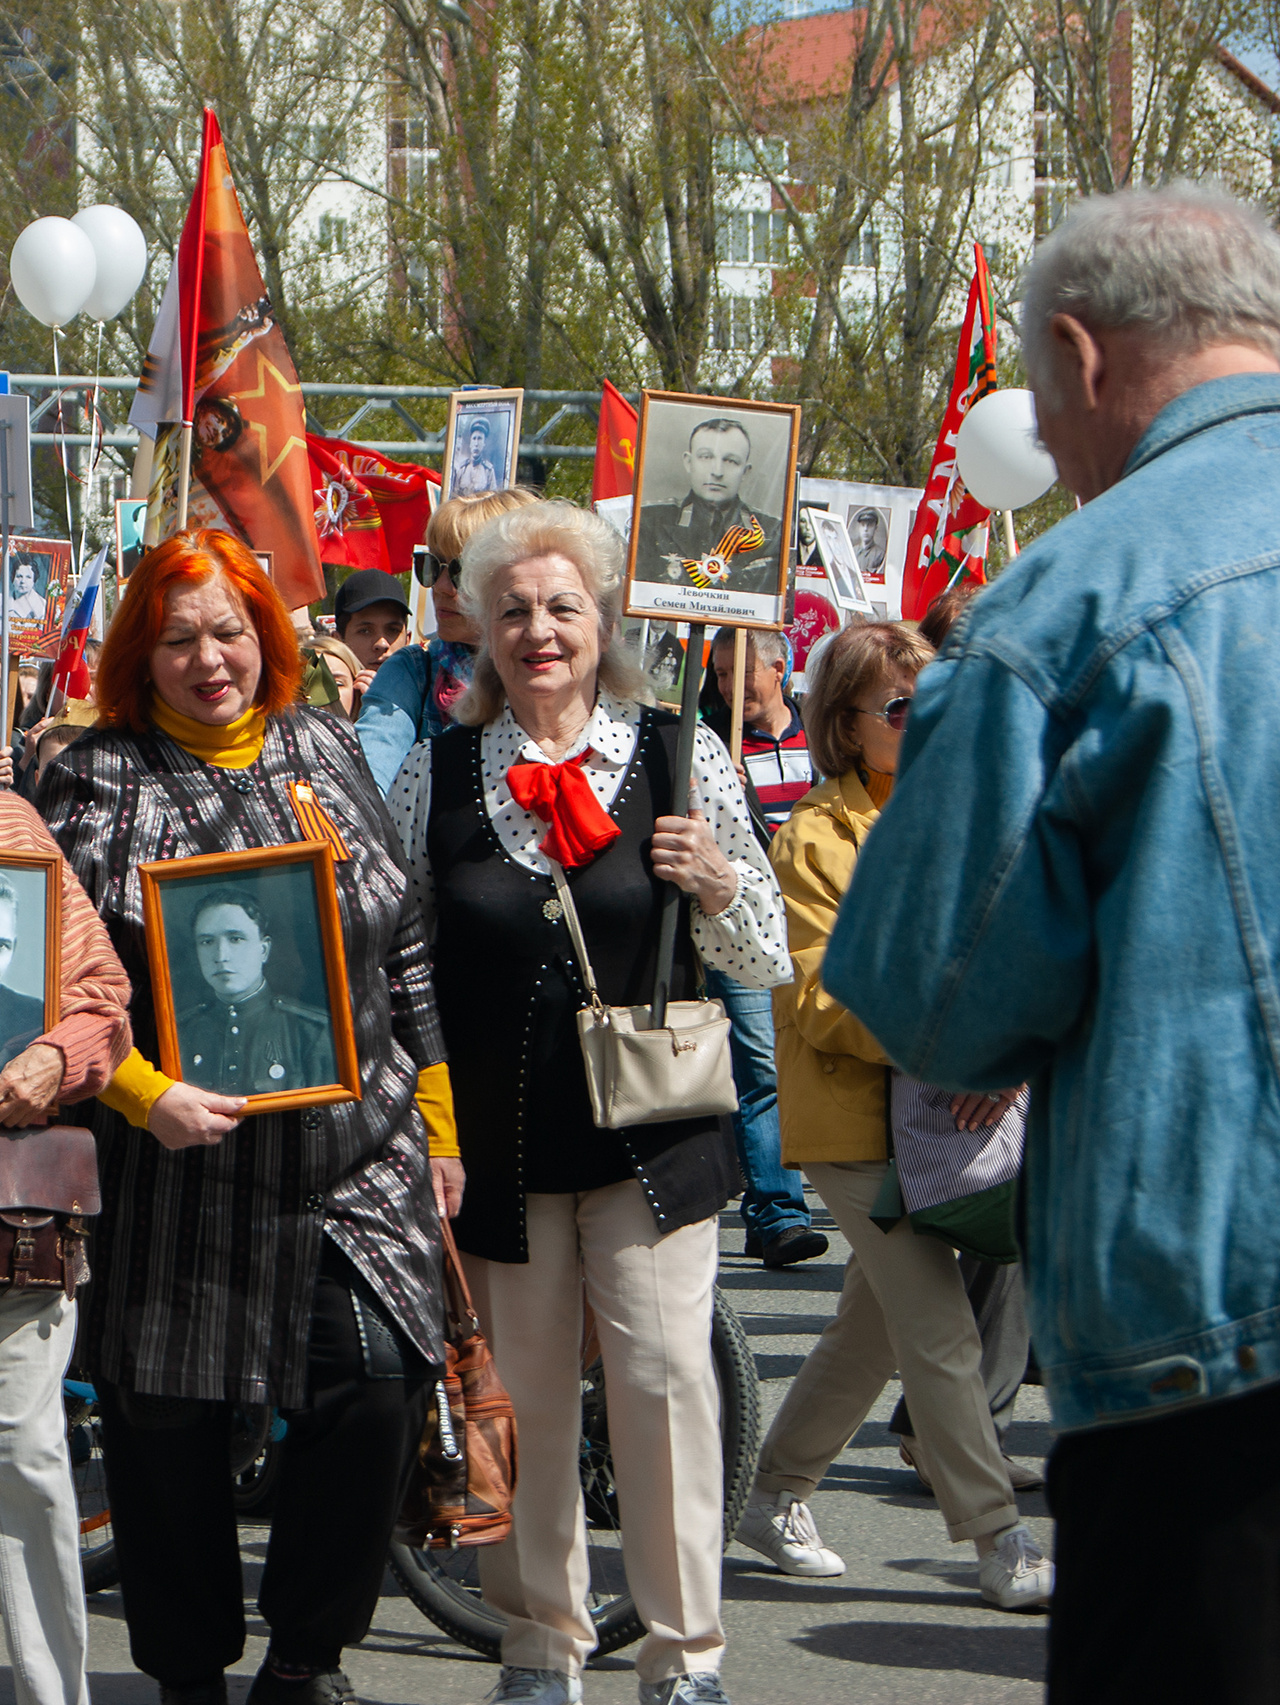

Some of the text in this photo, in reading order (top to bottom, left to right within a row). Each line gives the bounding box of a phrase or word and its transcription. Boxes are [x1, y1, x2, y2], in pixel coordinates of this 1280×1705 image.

[678, 587, 730, 600] Левочкин
[654, 597, 755, 616] Семен Михайлович
[436, 1391, 451, 1433] FASHION
